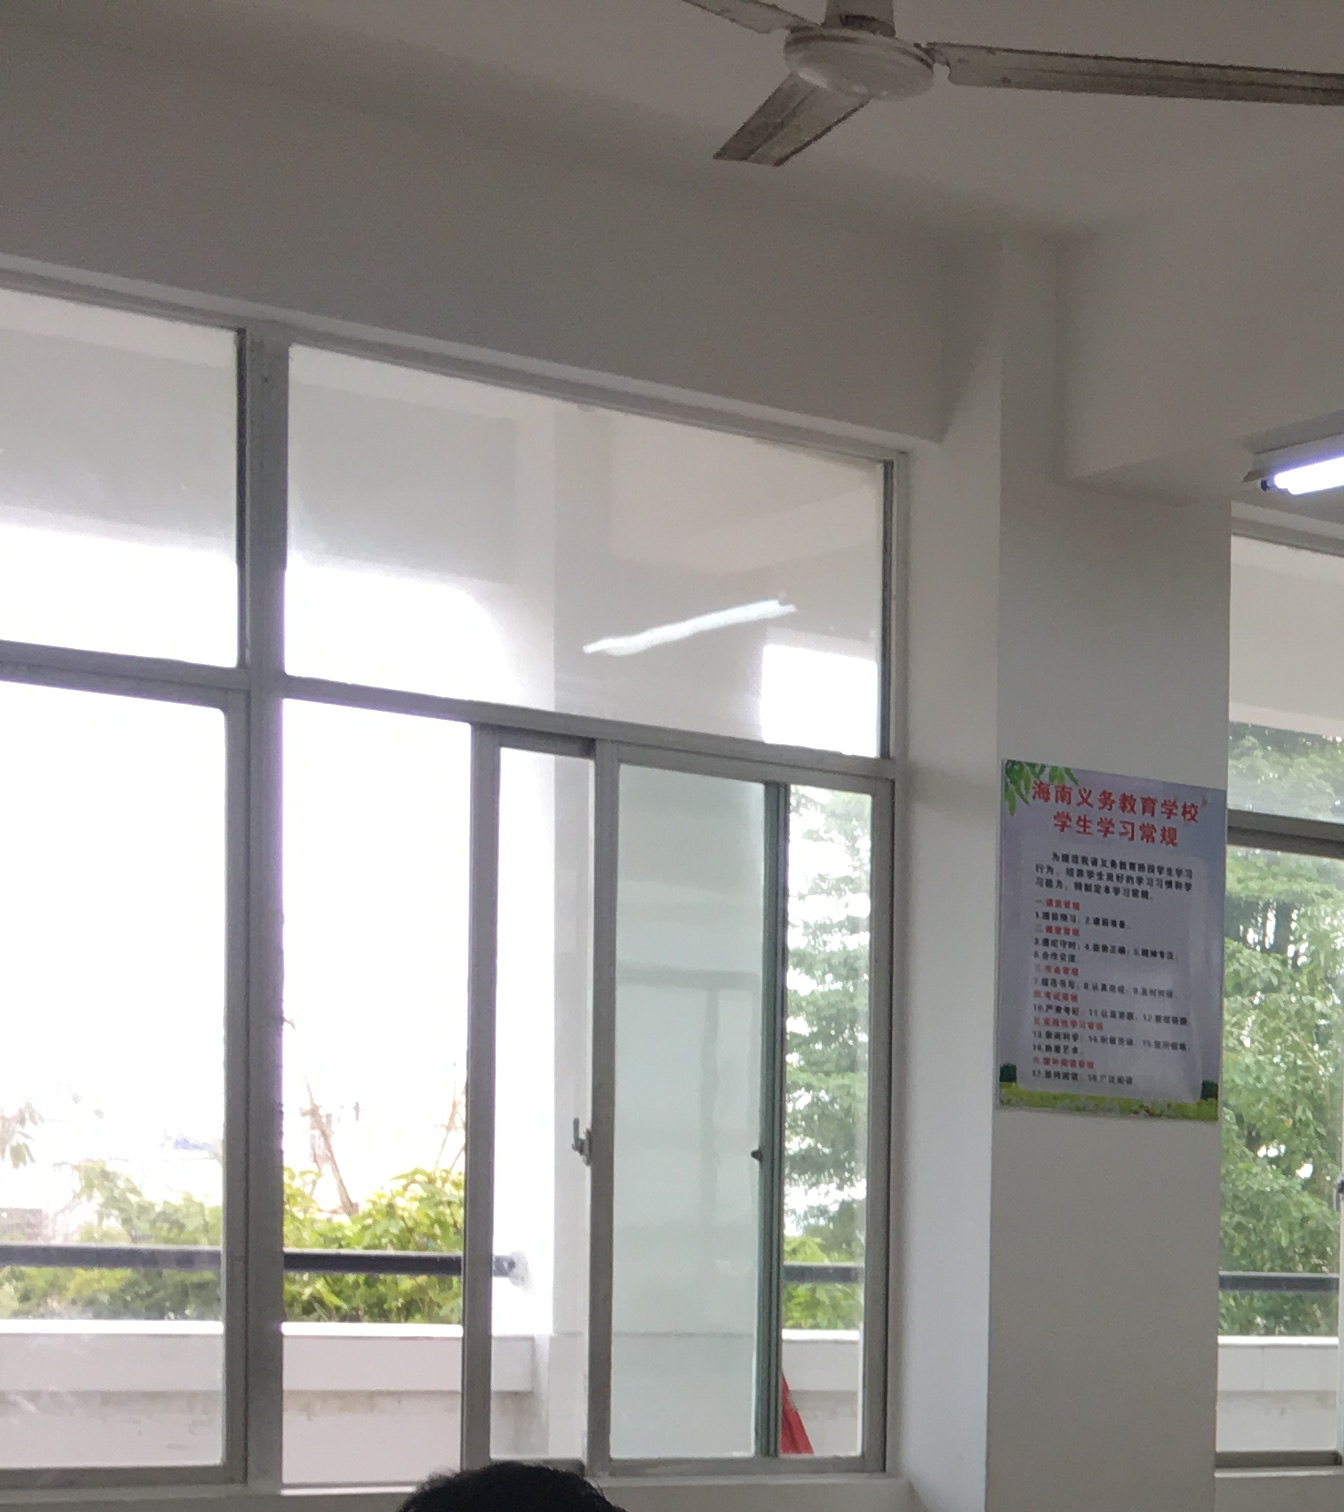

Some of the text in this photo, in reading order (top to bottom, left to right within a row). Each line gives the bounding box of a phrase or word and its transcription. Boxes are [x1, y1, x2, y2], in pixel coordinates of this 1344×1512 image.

[1032, 780, 1200, 824] 海南义务教育学校
[1053, 811, 1179, 847] 学生学习常规
